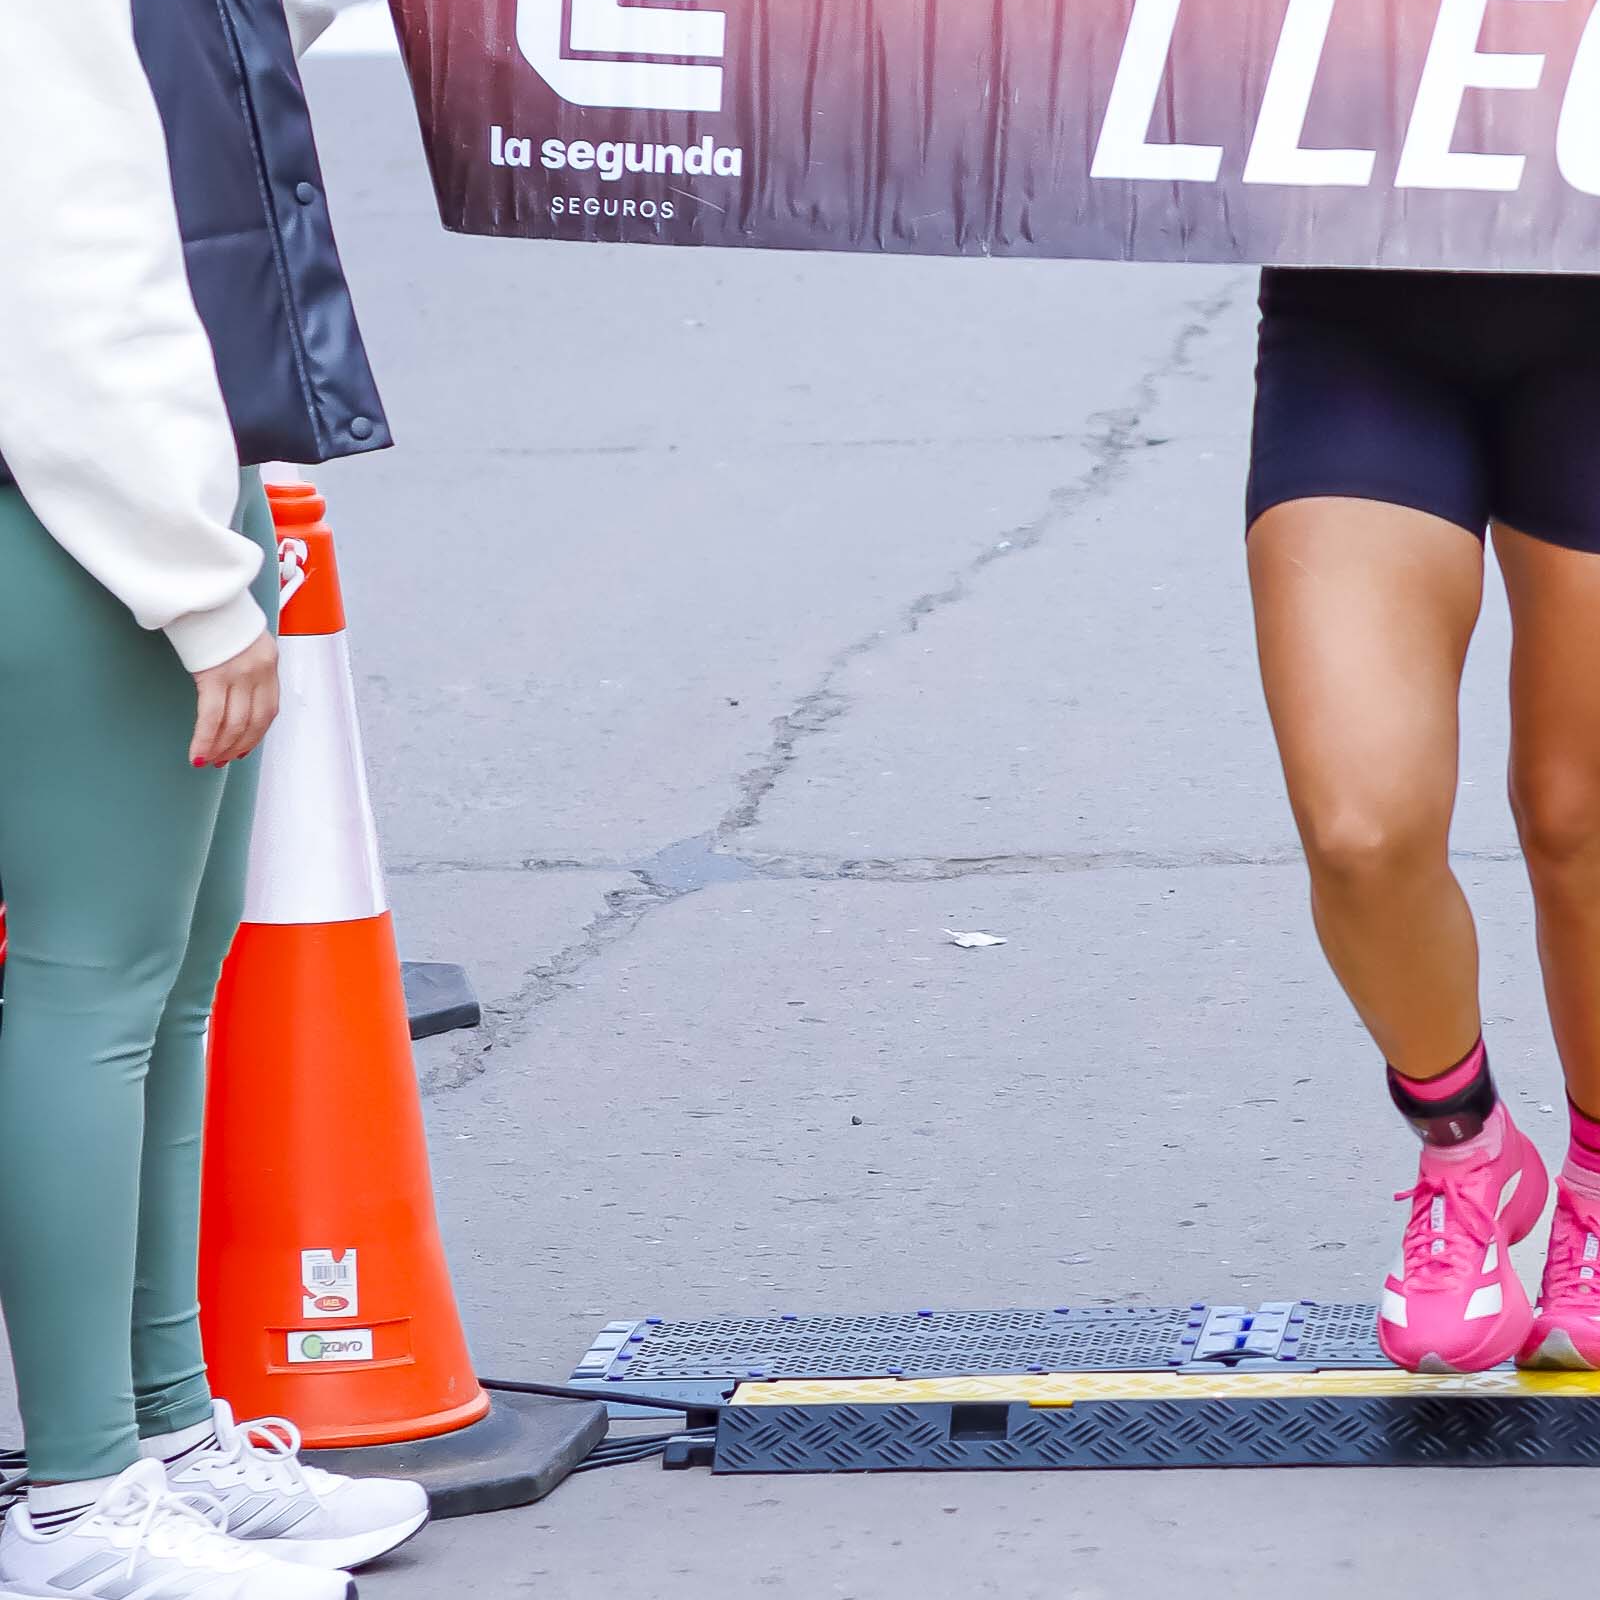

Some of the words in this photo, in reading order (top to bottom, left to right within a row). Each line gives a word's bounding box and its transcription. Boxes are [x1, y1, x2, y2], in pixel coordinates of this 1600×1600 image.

[490, 125, 531, 168] la
[540, 135, 743, 181] segunda
[551, 196, 675, 219] SEGUROS
